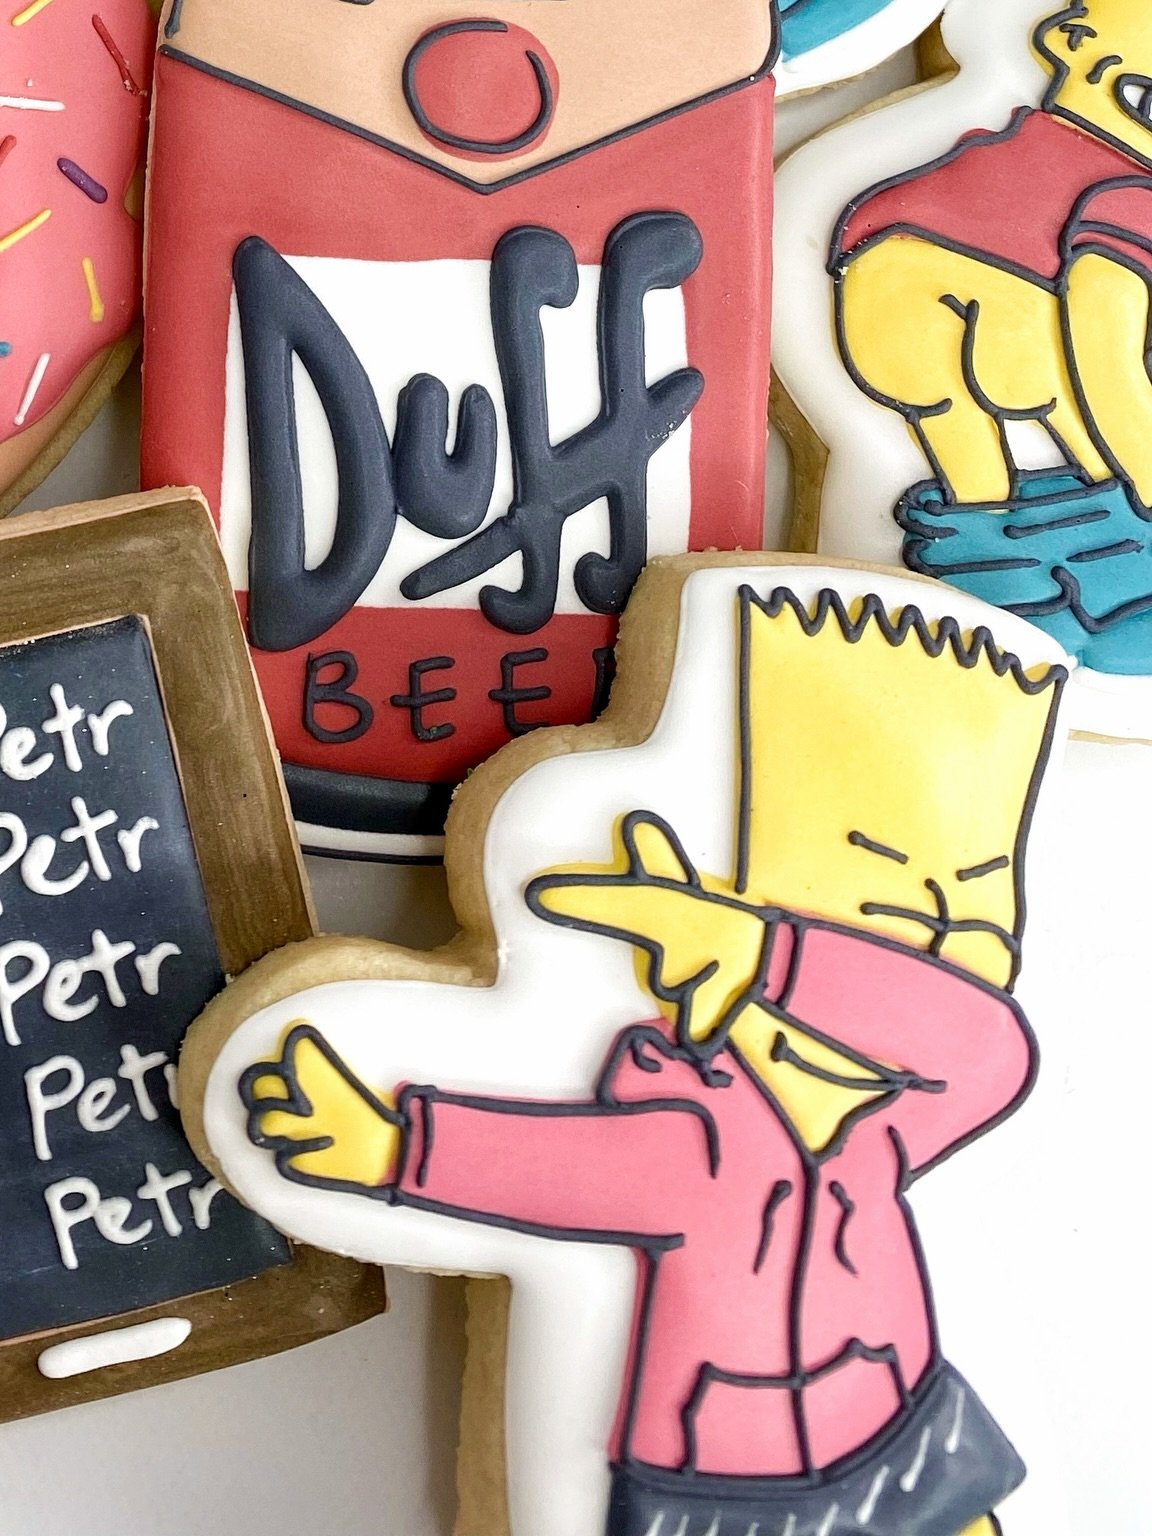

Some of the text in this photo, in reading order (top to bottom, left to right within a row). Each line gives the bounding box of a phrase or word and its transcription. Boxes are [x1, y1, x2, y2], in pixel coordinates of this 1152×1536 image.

[232, 210, 705, 652] Duff
[302, 647, 617, 743] BEE
[45, 1163, 224, 1269] Petr
